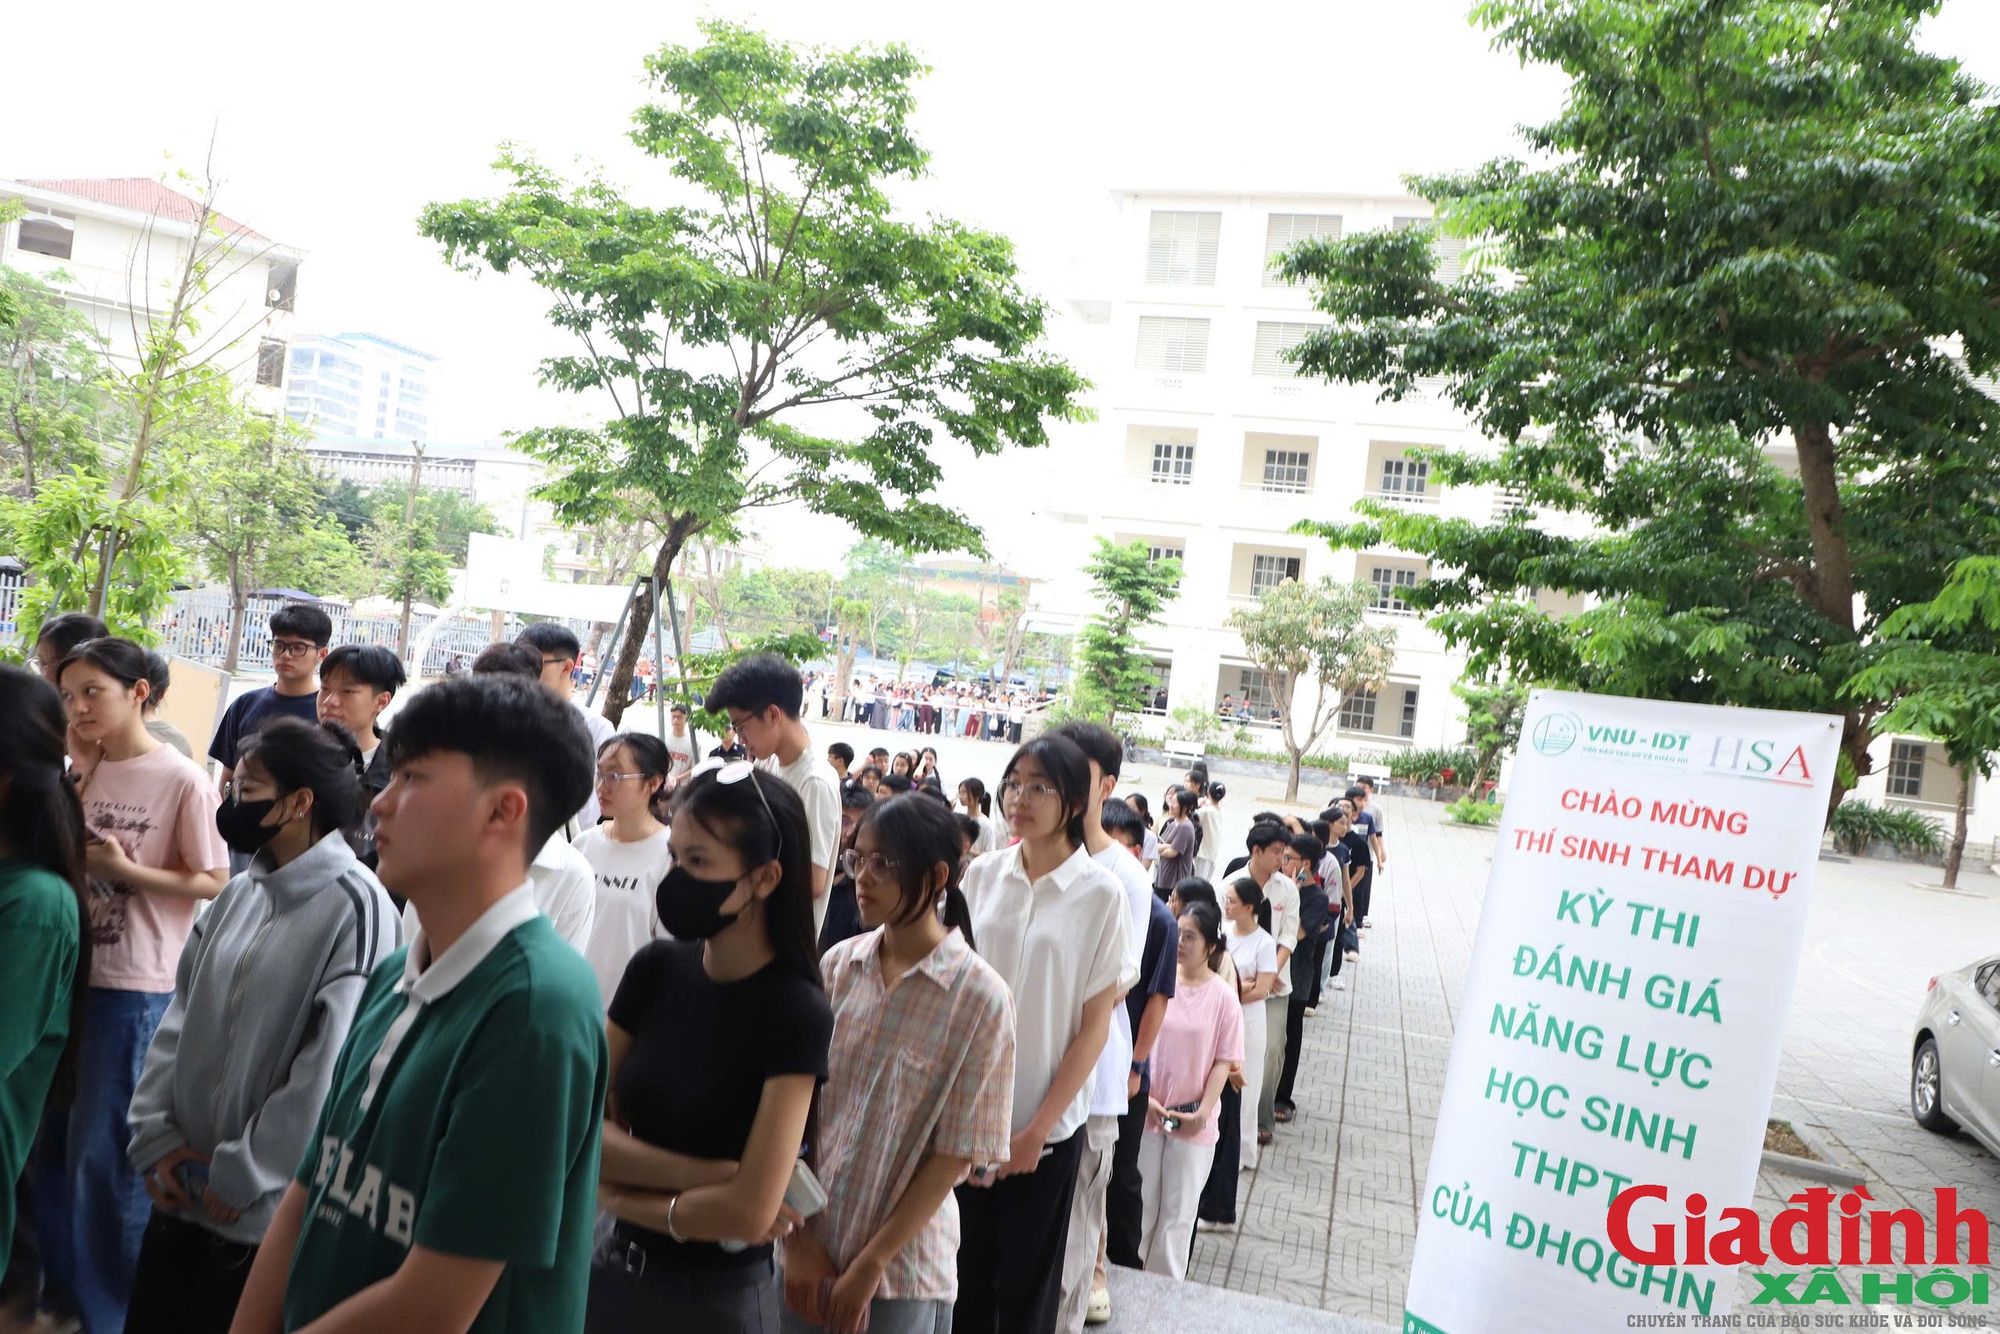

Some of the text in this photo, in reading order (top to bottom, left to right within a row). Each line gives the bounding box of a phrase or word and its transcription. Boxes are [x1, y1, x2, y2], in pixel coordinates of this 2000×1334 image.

[1587, 725, 1637, 746] VNU
[1651, 732, 1692, 752] IDT
[1709, 735, 1813, 779] HSA
[1560, 788, 1749, 836] CHÀO MỪNG
[1513, 828, 1798, 901] THÍ SINH THAM DỰ
[1556, 886, 1701, 948] KỲ THI
[1513, 942, 1723, 1024] ĐÁNH GIÁ
[1489, 1001, 1713, 1090] NĂNG LỰC
[1484, 1065, 1698, 1161] HỌC SINH
[1511, 1140, 1633, 1208] THPT
[1431, 1180, 1717, 1317] CỦA ĐHQGHN
